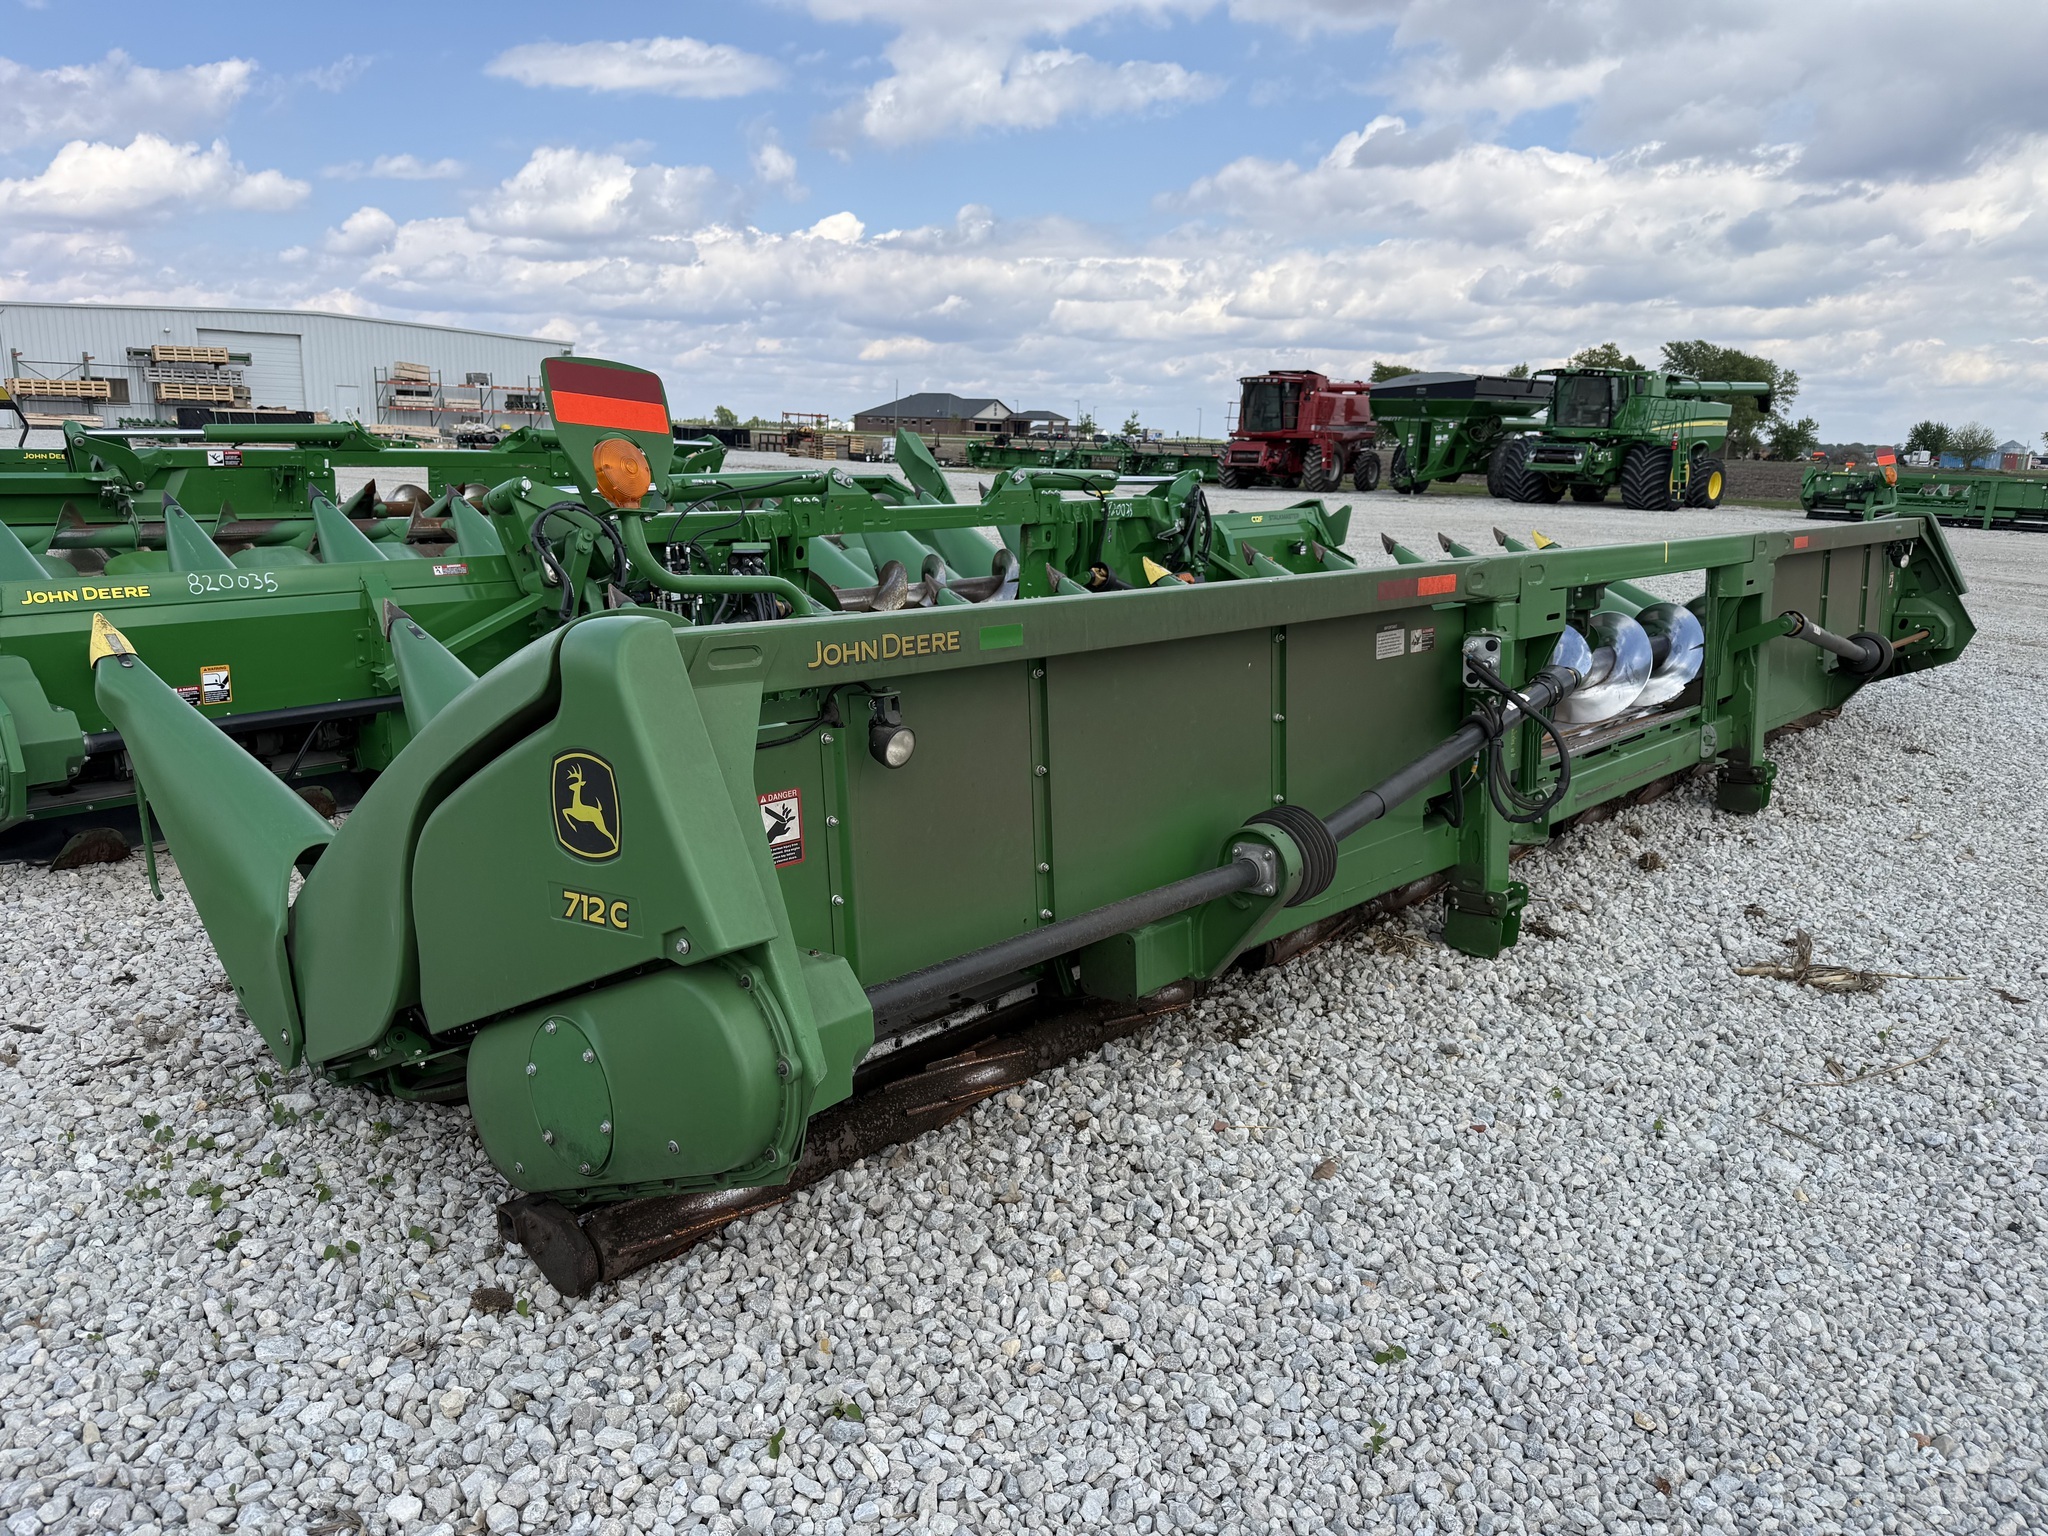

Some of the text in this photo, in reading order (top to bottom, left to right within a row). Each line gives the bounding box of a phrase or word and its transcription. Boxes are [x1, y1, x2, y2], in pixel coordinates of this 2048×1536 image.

[23, 452, 48, 460] JOHN
[187, 572, 279, 595] 820035
[21, 585, 152, 606] JOHN DEERE
[807, 630, 961, 669] JOHN DEERE
[768, 789, 797, 801] DANGER
